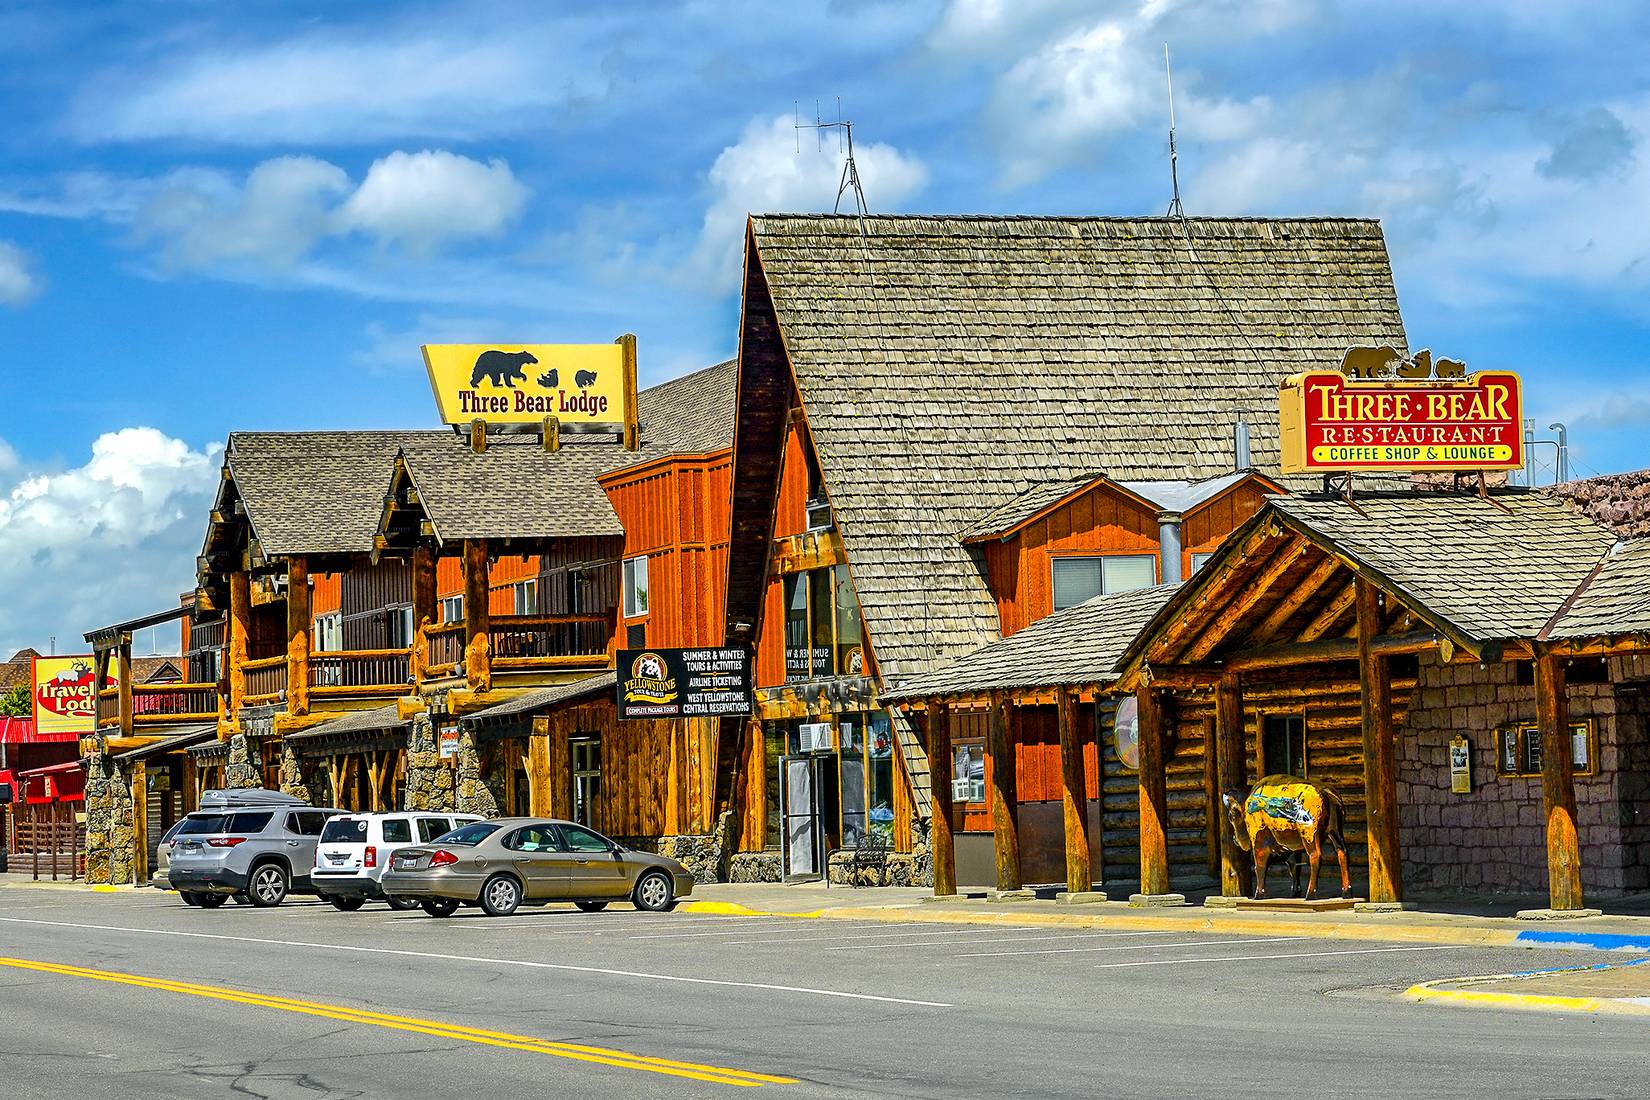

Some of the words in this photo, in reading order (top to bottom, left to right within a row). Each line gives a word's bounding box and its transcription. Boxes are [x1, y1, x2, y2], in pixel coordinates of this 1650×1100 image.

[459, 390, 509, 413] Three
[513, 390, 554, 413] Bear
[558, 390, 608, 417] Lodge
[1309, 384, 1411, 421] THREE
[1427, 384, 1512, 421] BEAR
[1330, 447, 1379, 460] COFFEE
[1386, 447, 1420, 460] SHOP
[1426, 447, 1439, 460] &
[1444, 446, 1495, 459] LOUNGE
[682, 651, 711, 661] SUMMER
[712, 651, 718, 660] &
[719, 650, 745, 660] WINTER
[686, 662, 705, 671] TOURS
[706, 662, 711, 671] &
[712, 660, 743, 670] ACTIVITIES
[624, 678, 676, 692] YELLOWSTONE
[689, 677, 711, 687] AIRLINE
[712, 676, 742, 686] TICKETING
[55, 695, 96, 711] Lod
[687, 693, 703, 703] WEST
[704, 692, 744, 702] YELLOWSTONE
[683, 703, 708, 714] CENTRAL
[709, 702, 750, 713] RESERVATIONS
